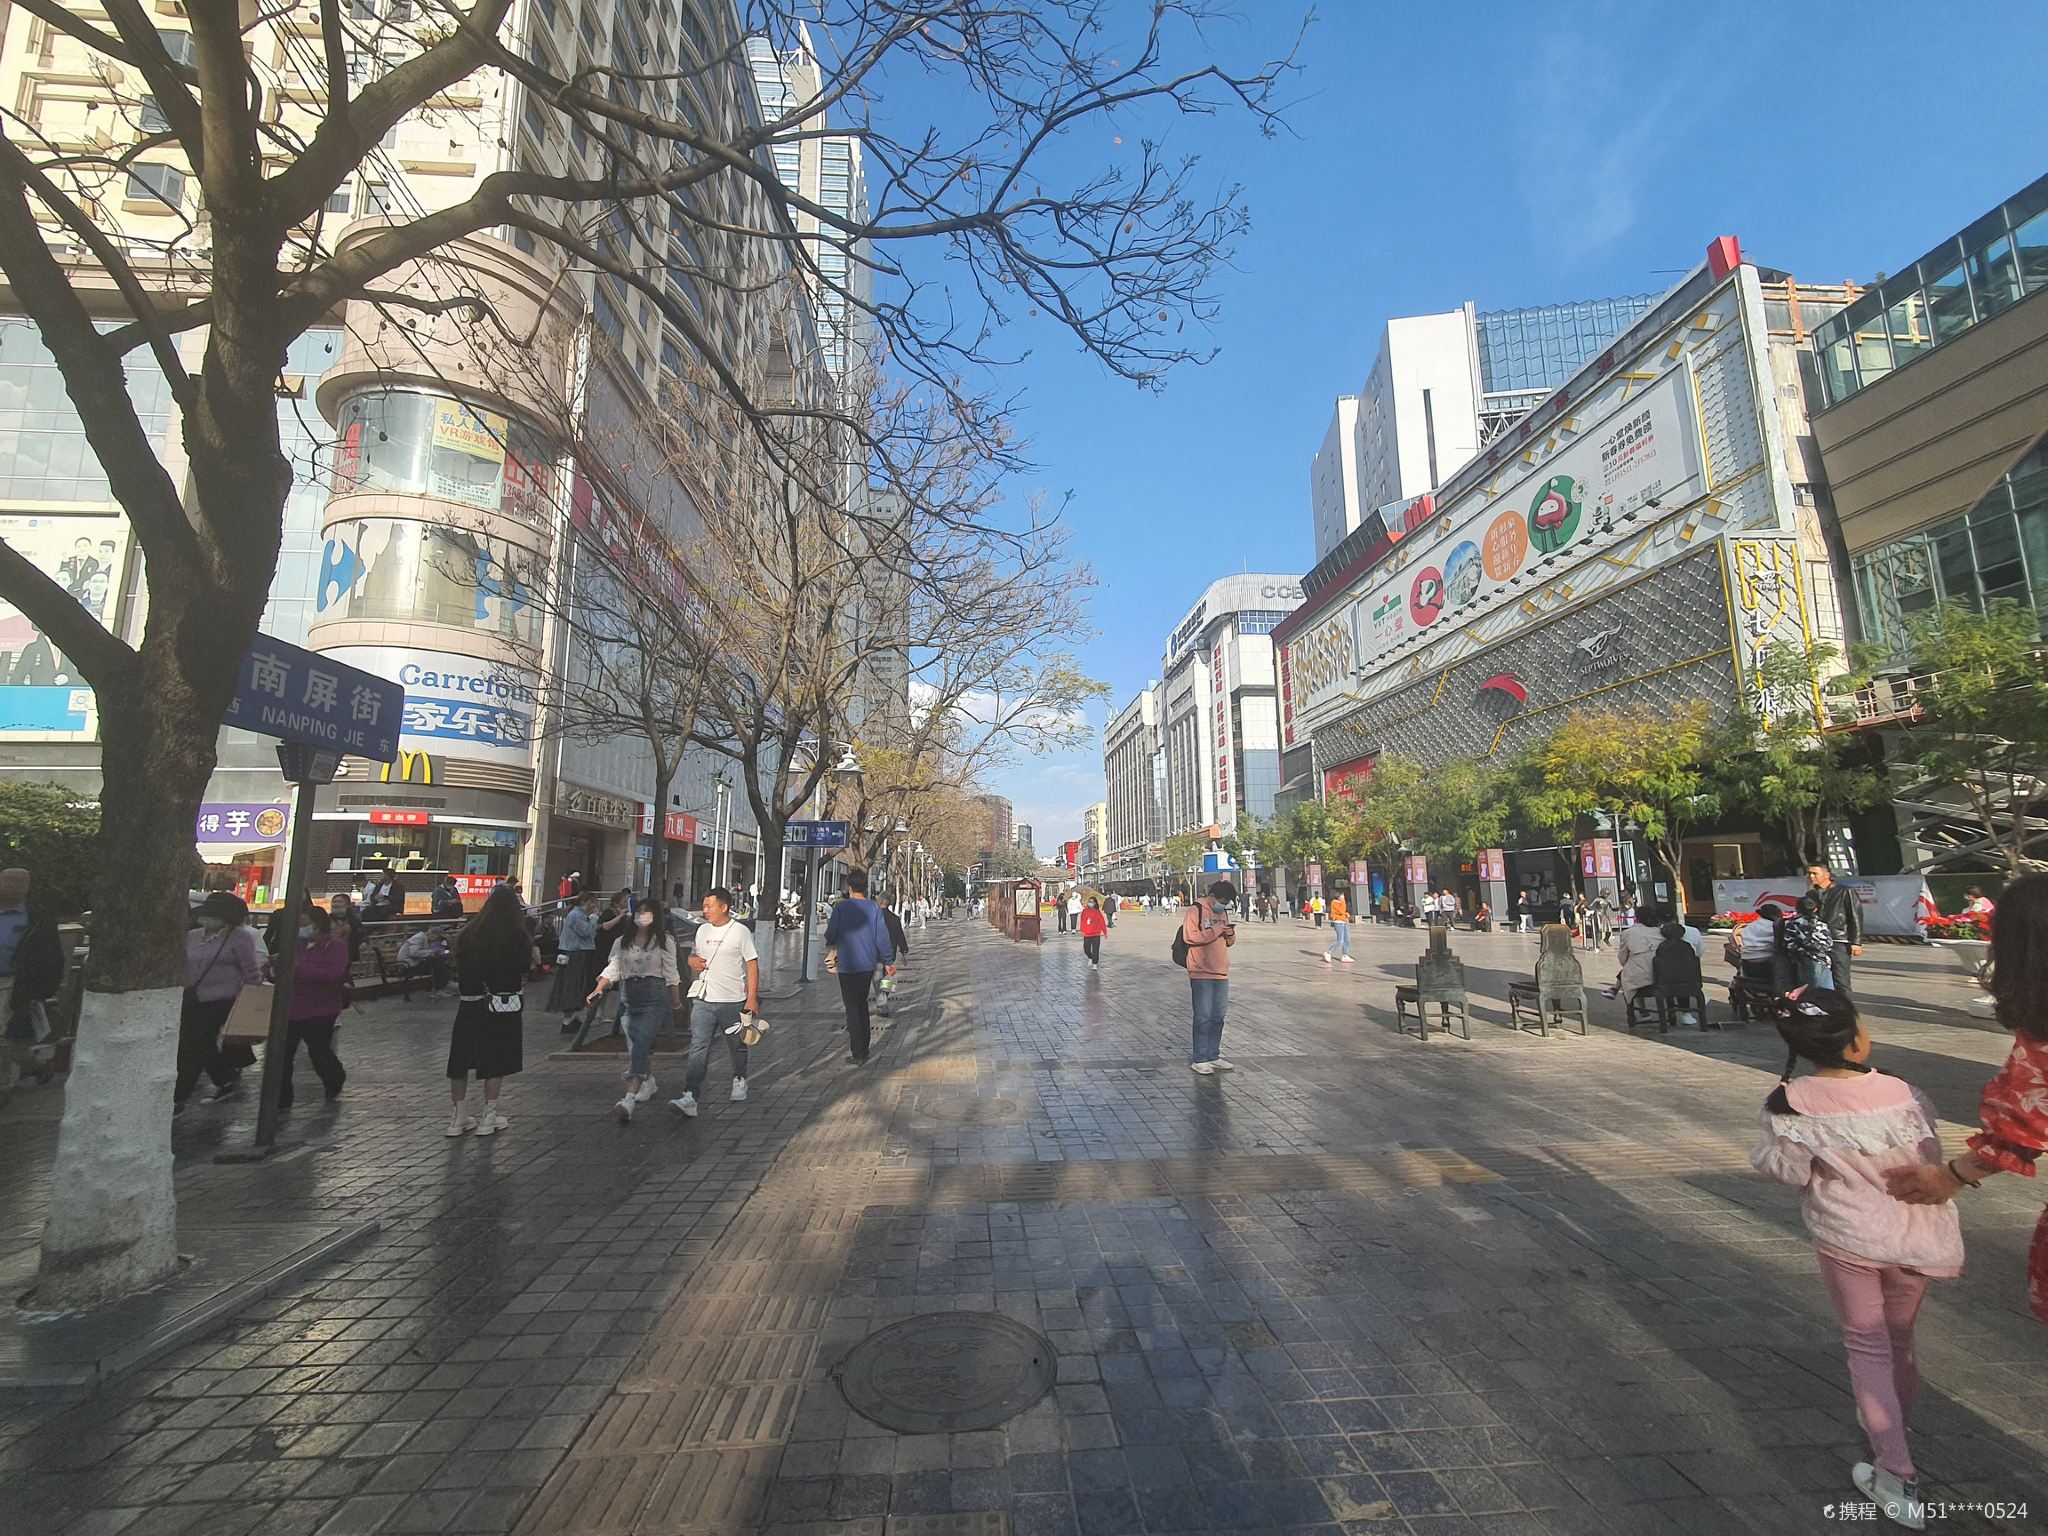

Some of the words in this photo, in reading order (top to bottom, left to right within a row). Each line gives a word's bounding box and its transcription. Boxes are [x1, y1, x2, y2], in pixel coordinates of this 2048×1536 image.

[503, 449, 549, 499] 出租
[1375, 616, 1404, 639] 一心堂
[1580, 651, 1631, 676] SEPTWOLVES
[251, 652, 382, 726] 南屏街
[262, 705, 338, 740] NANPING
[344, 728, 365, 747] JIE
